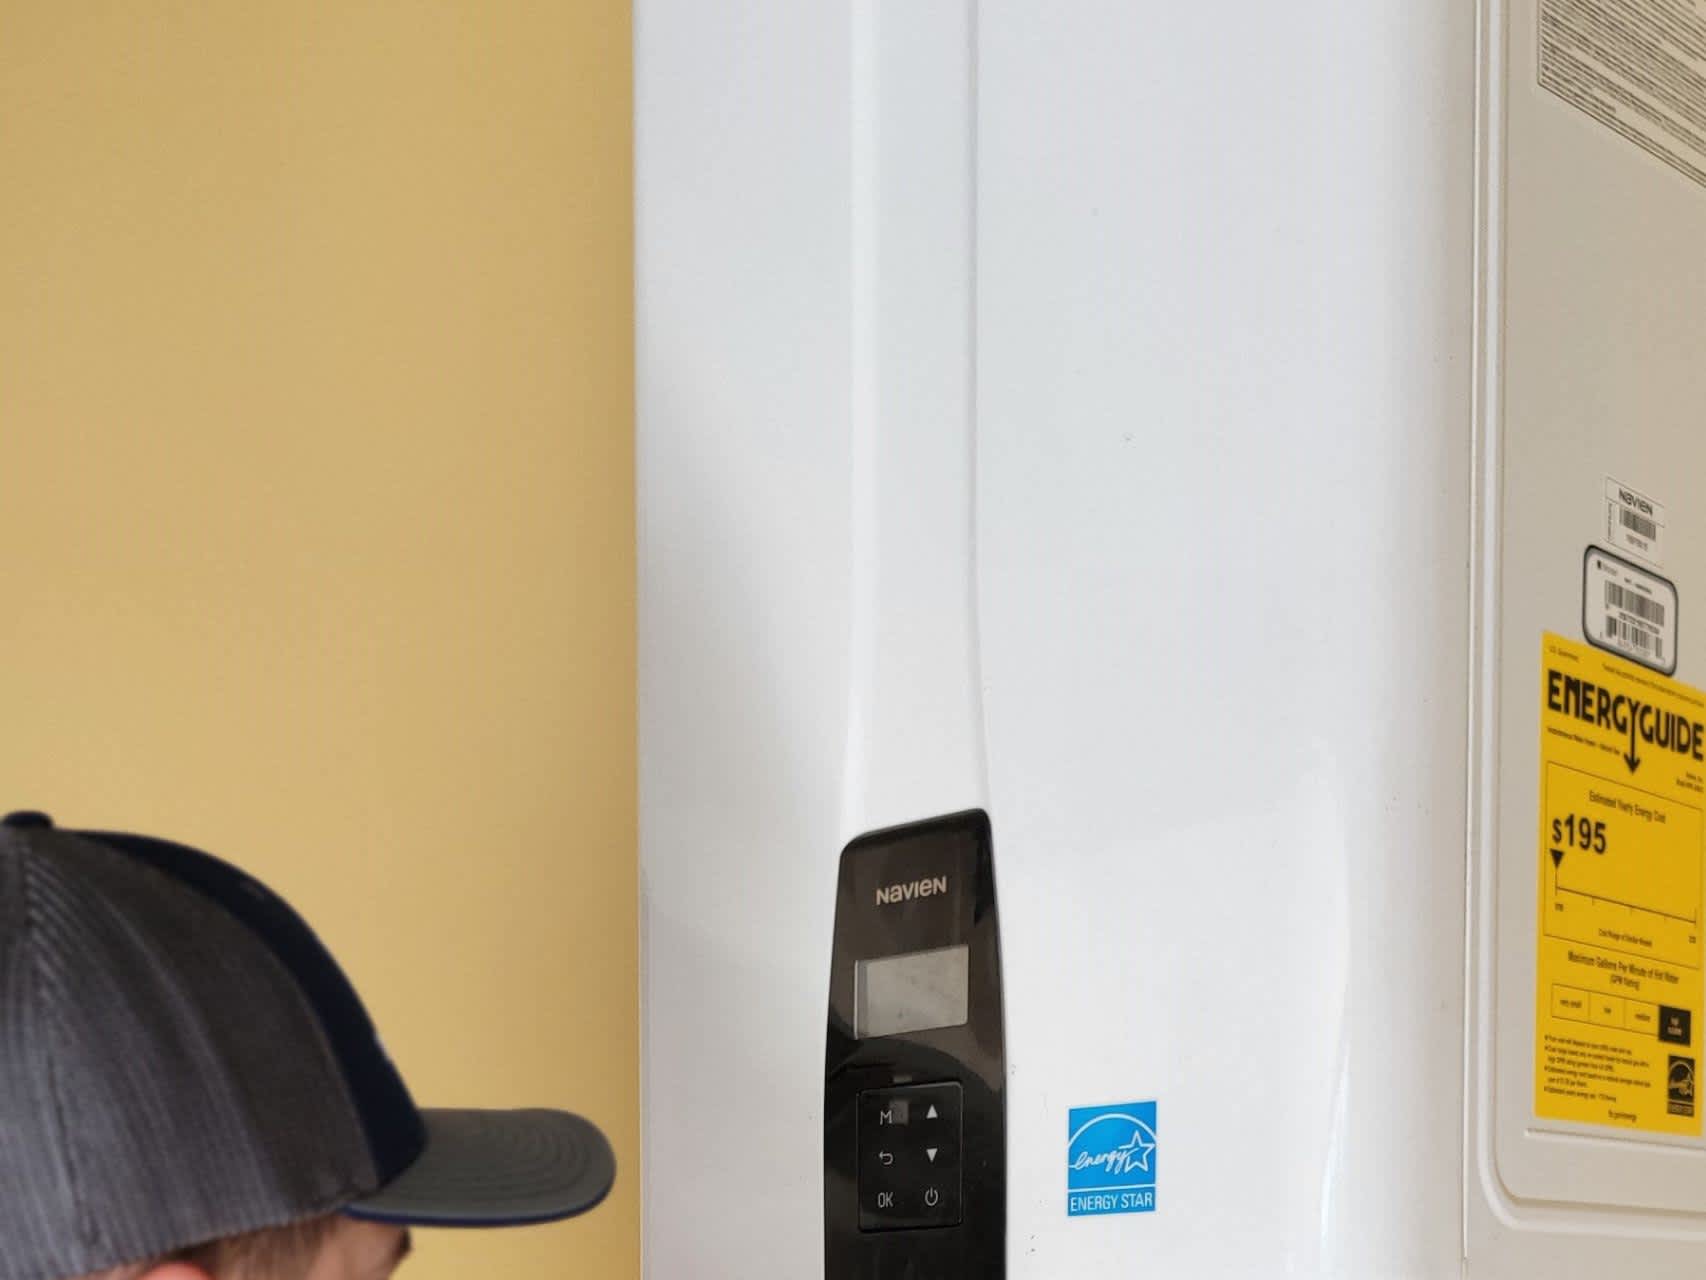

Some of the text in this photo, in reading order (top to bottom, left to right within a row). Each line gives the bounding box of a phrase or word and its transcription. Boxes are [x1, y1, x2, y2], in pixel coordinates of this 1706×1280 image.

[1547, 667, 1705, 764] ENERGYGUIDE
[1552, 813, 1606, 855] $195
[880, 1110, 893, 1126] M
[878, 1191, 894, 1209] OK
[1070, 1191, 1153, 1212] ENERGY STAR
